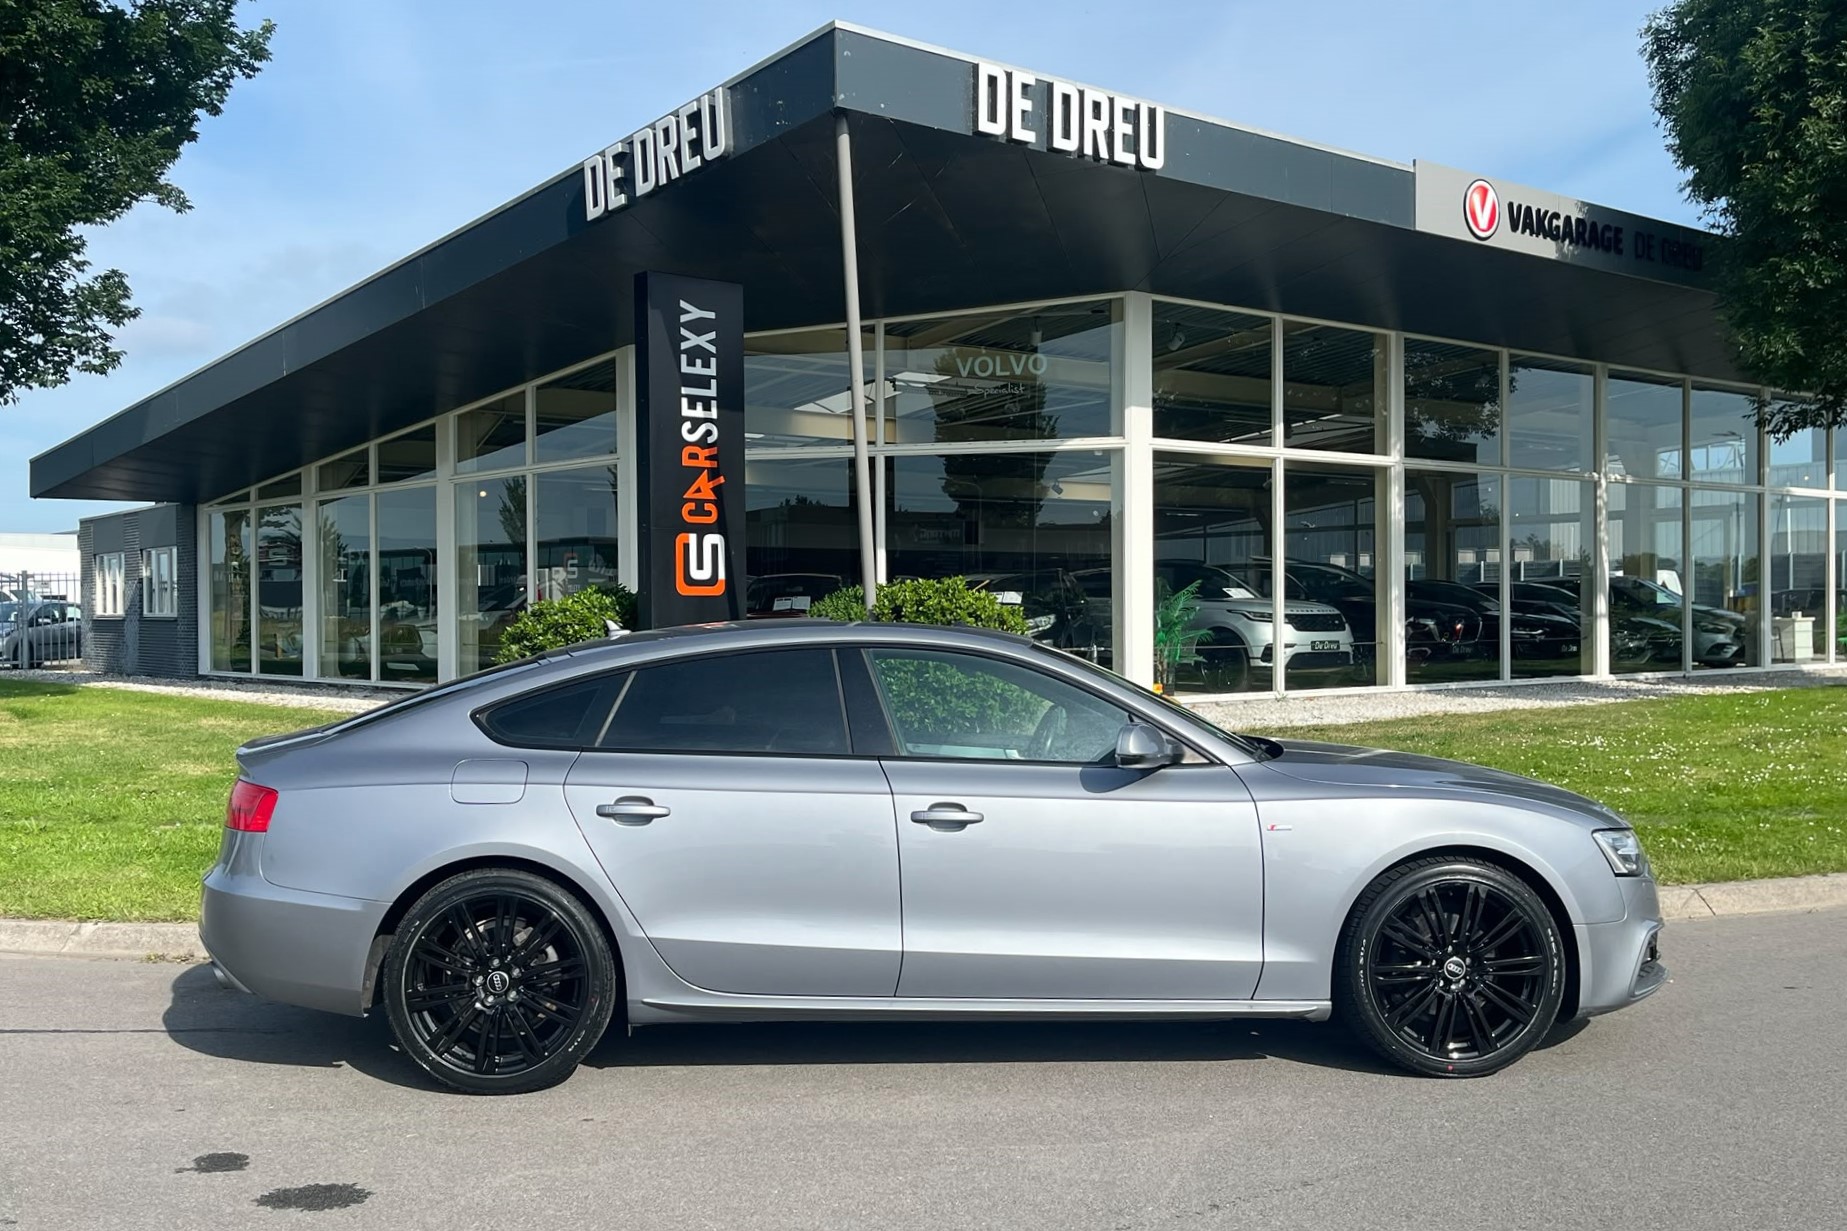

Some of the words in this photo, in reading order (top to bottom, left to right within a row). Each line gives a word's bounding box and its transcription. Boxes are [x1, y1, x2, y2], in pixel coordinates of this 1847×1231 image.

[583, 142, 630, 223] DE
[632, 86, 732, 198] DREU
[976, 60, 1037, 144] DE
[1051, 80, 1166, 171] DREU
[1507, 200, 1624, 256] VAKGARAGE
[1634, 230, 1656, 262] DE
[956, 352, 1048, 378] VOLVO
